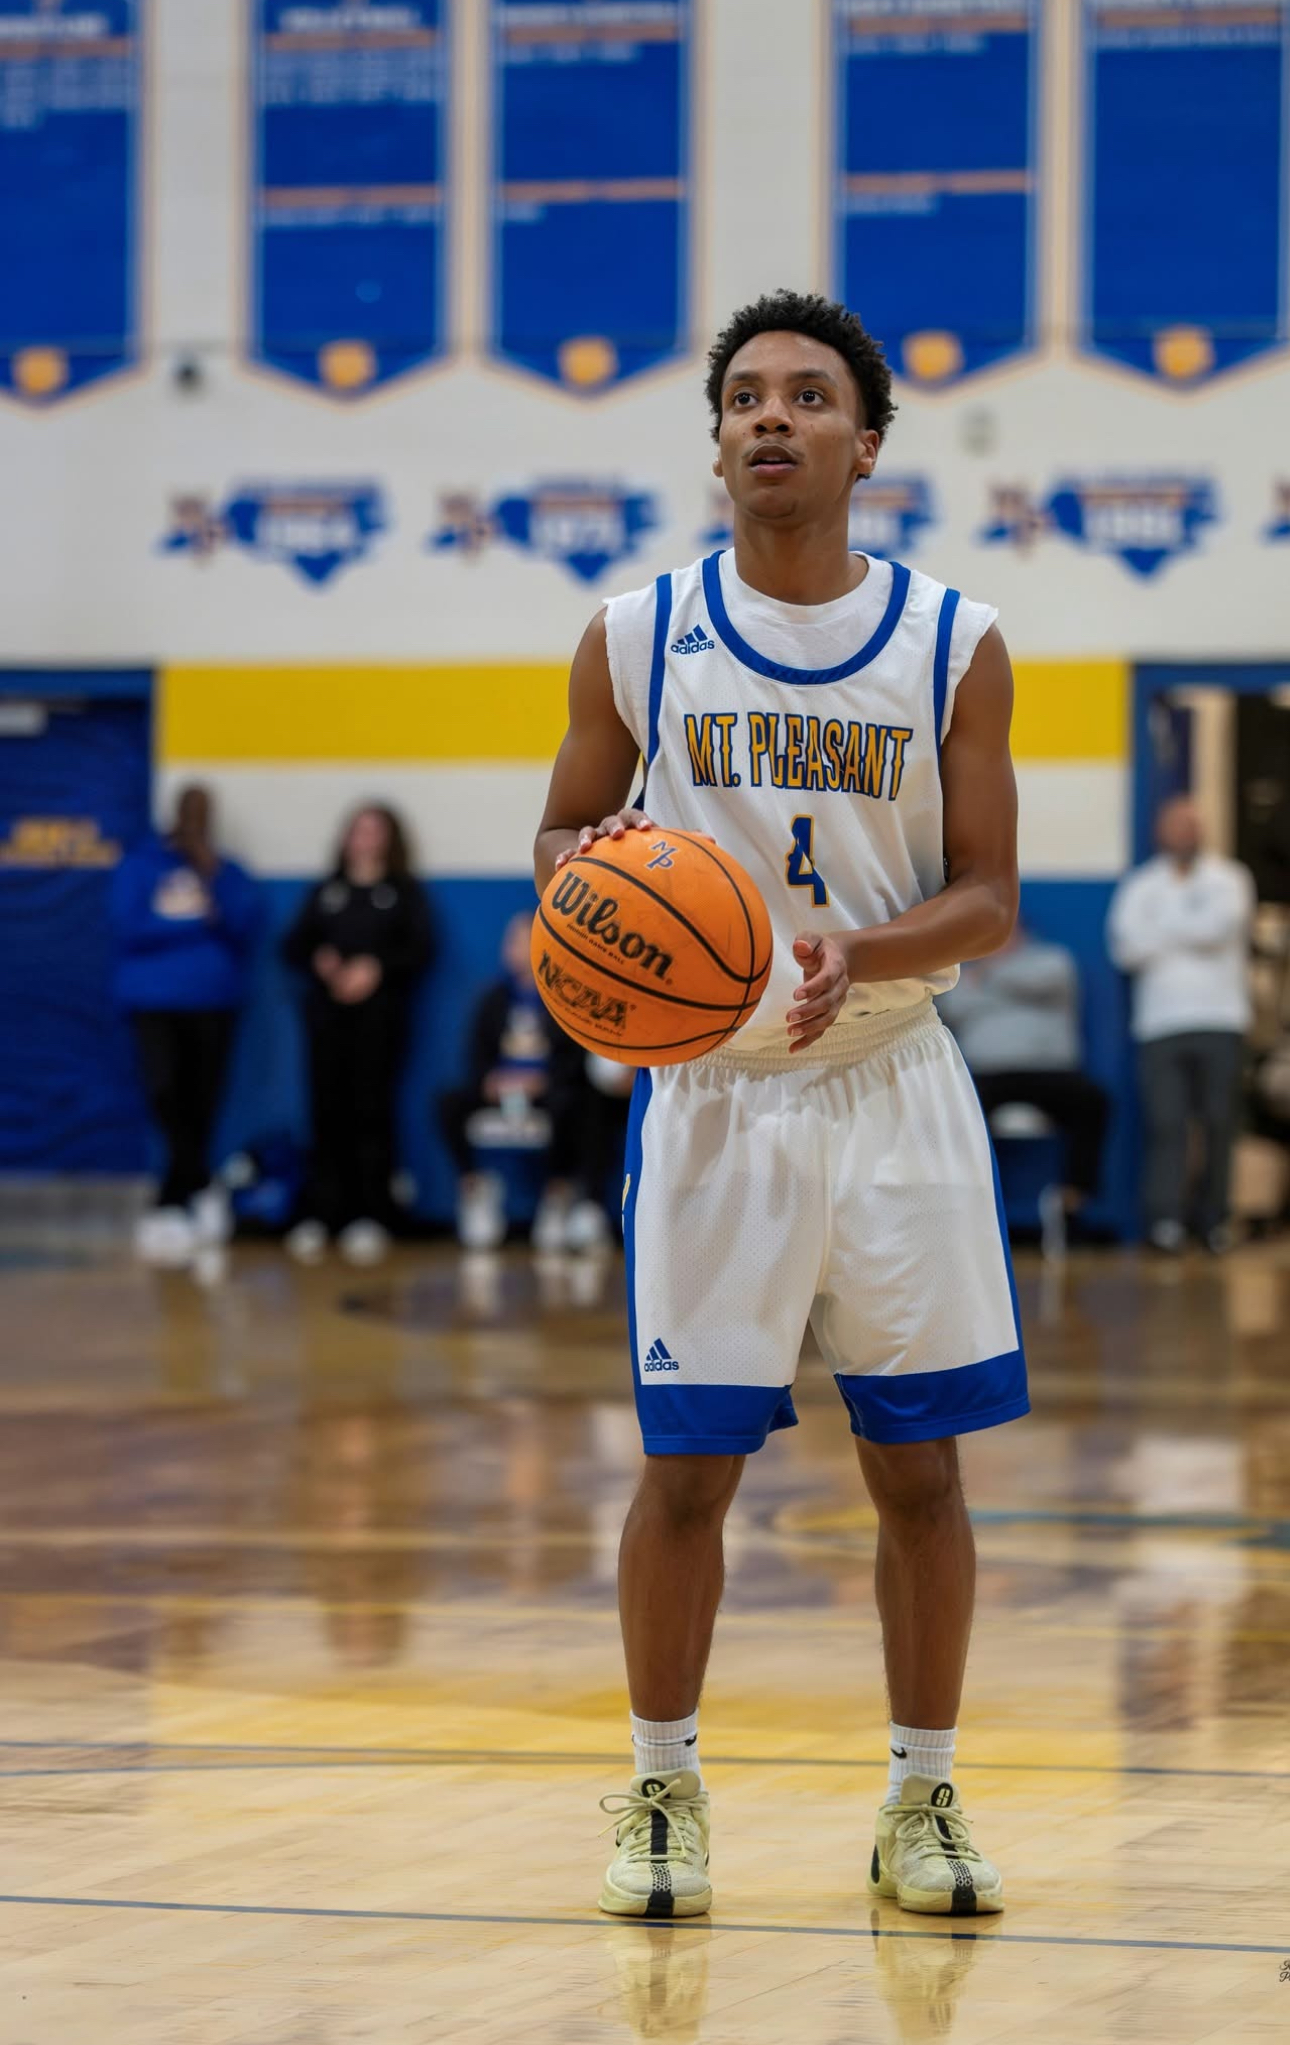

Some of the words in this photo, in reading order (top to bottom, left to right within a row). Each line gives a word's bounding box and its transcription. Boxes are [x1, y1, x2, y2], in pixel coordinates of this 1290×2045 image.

[670, 638, 715, 655] adidas
[684, 712, 741, 788] MT.
[747, 711, 913, 801] PLEASANT
[785, 814, 830, 909] 4
[552, 871, 672, 977] Wilson
[538, 951, 627, 1029] NCAA
